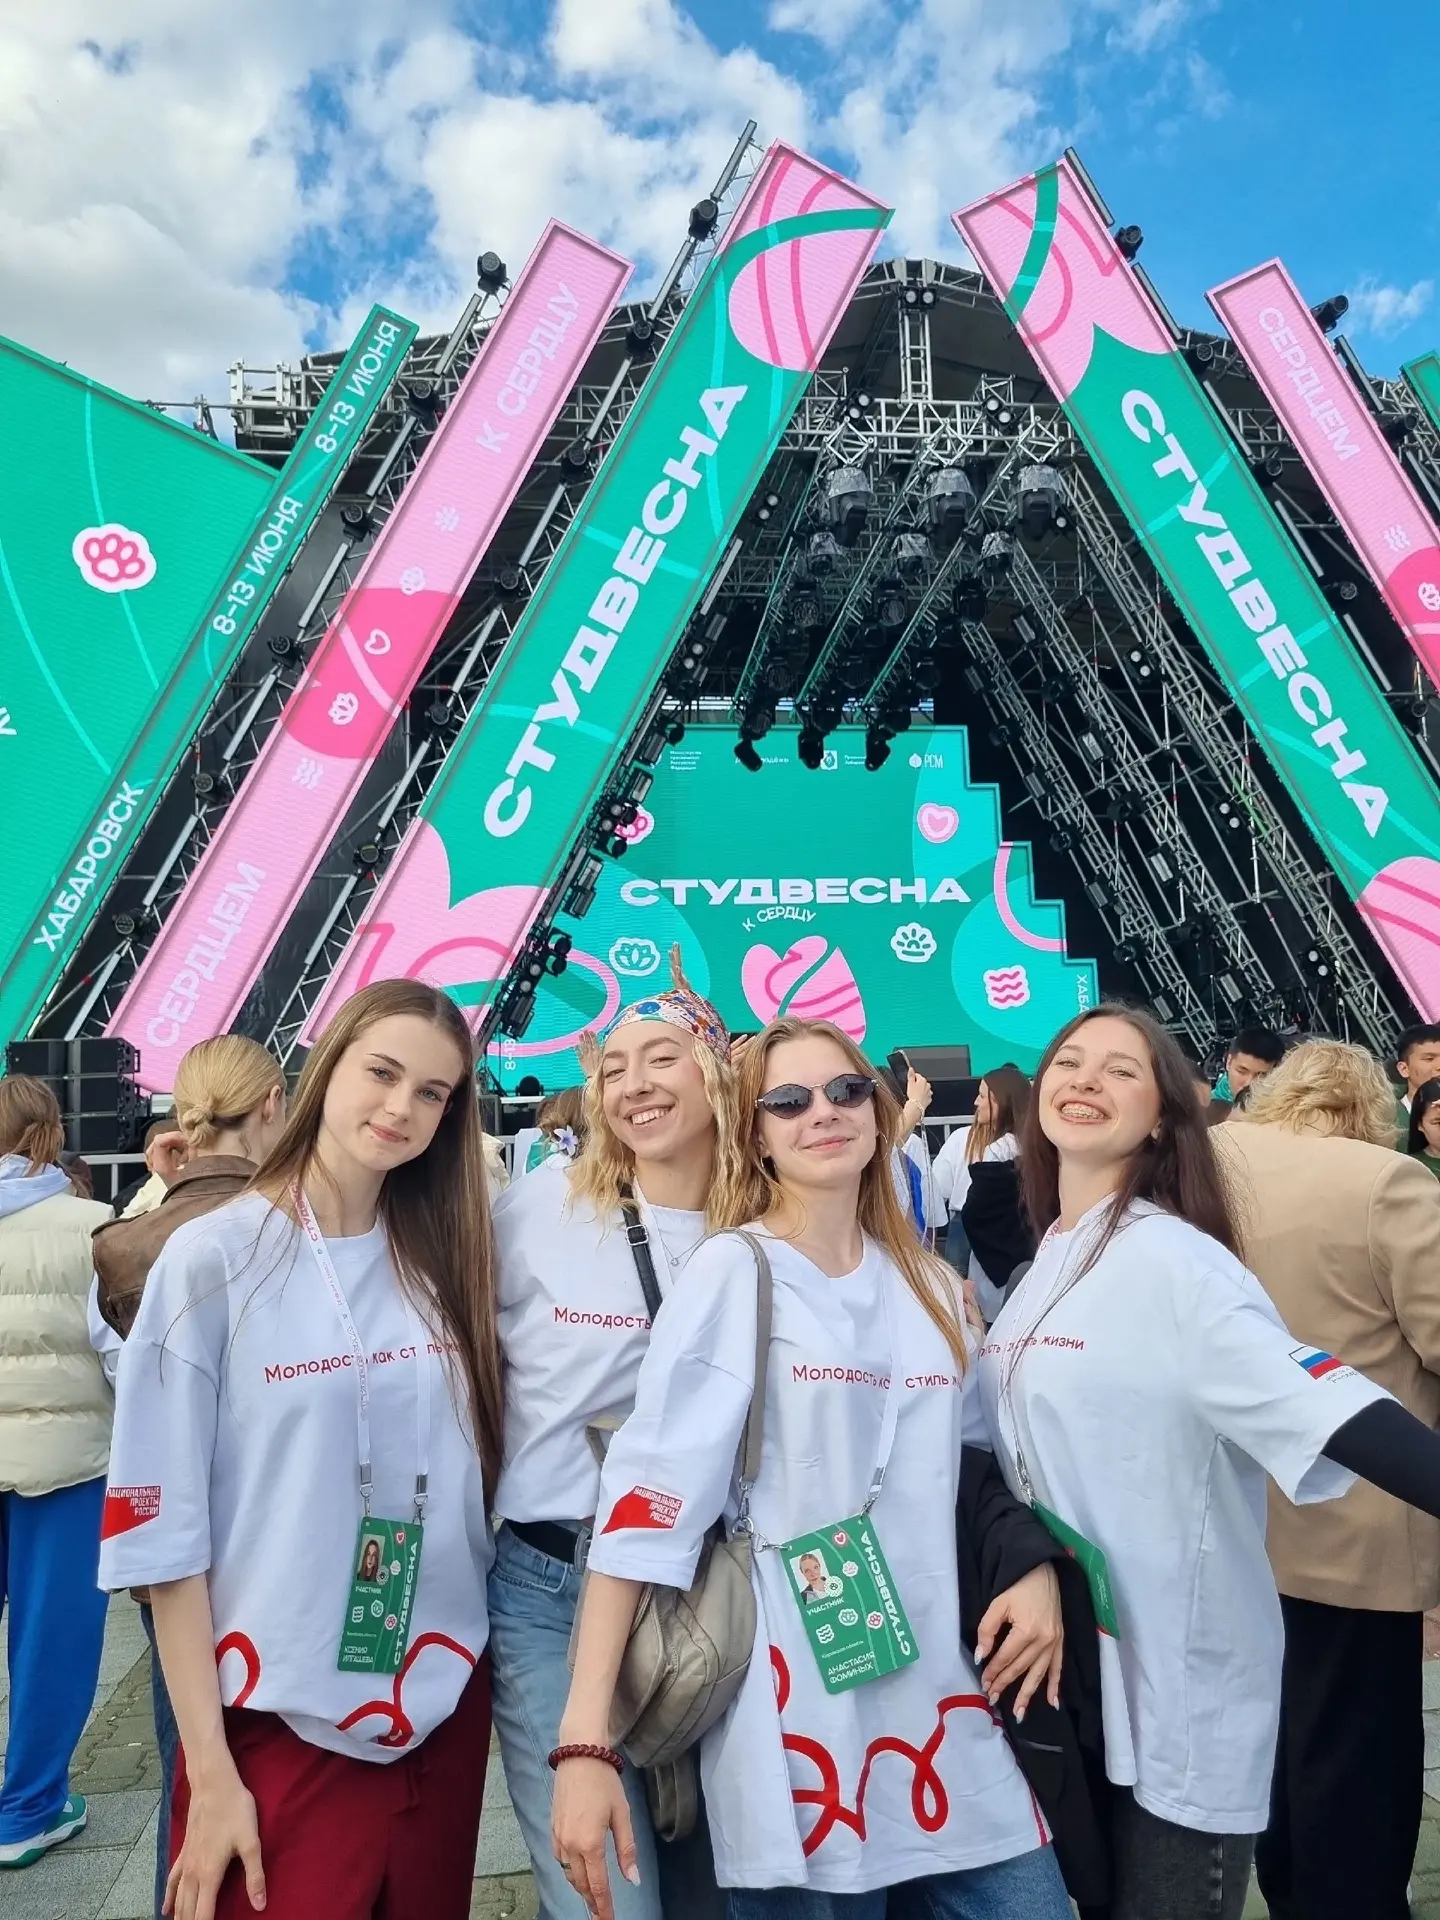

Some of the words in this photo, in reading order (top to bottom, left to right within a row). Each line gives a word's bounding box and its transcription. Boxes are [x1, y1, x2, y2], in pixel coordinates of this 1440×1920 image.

[351, 320, 402, 402] ИЮНЯ
[476, 420, 509, 454] К
[496, 281, 580, 416] СЕРДЦУ
[1257, 306, 1361, 461] СЕРДЦЕМ
[246, 496, 304, 584] ИЮНЯ
[483, 383, 748, 838] СТУДВЕСНА
[1121, 389, 1389, 838] СТУДВЕСНА
[33, 780, 145, 952] ХАБАРОВСК
[620, 877, 972, 906] СТУДВЕСНА
[742, 919, 756, 932] К
[757, 905, 817, 923] СЕРДЦУ
[147, 861, 267, 1049] СЕРДЦЕМ
[554, 1307, 652, 1329] Молодость
[264, 1351, 369, 1384] Молодос
[372, 1350, 396, 1365] как
[399, 1342, 443, 1359] стль
[1040, 1336, 1085, 1351] жизни
[792, 1364, 877, 1388] Молодость
[905, 1374, 950, 1389] стиль
[130, 1497, 159, 1507] ПРОЕКТЫ
[355, 1585, 382, 1595] УЧАСТНИК
[394, 1541, 418, 1665] СТУДВЕСНА
[806, 1597, 845, 1616] УЧАСТНИК
[860, 1530, 911, 1656] СТУДВЕСНА
[828, 1650, 875, 1676] АНАСТАСИЯ
[829, 1661, 874, 1684] ФОМИНЫХ
